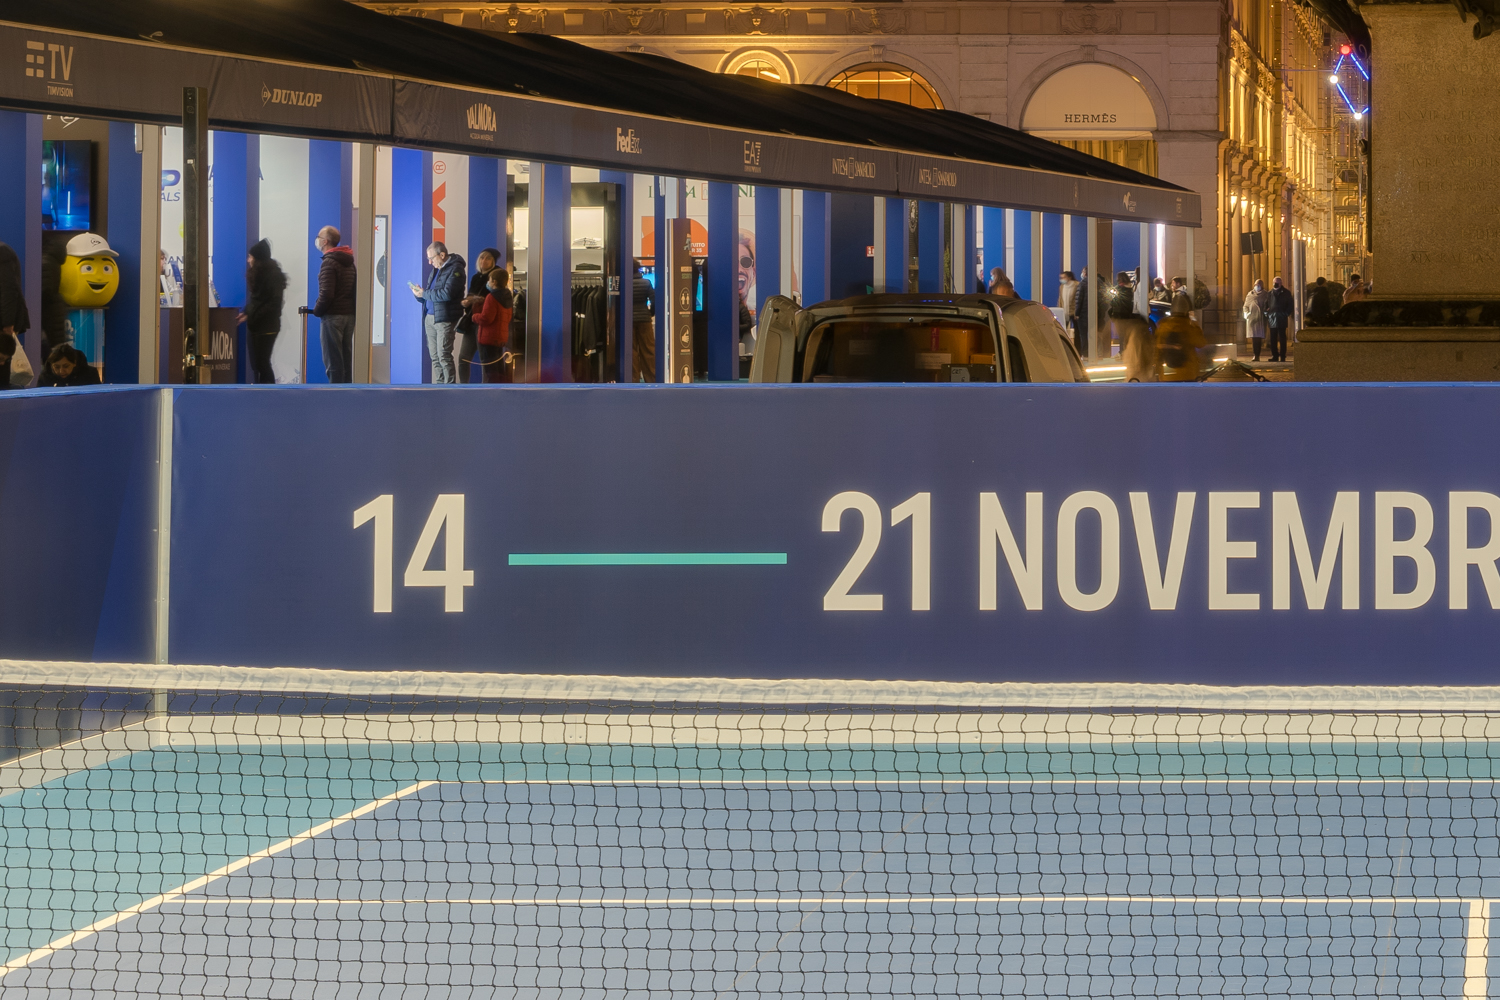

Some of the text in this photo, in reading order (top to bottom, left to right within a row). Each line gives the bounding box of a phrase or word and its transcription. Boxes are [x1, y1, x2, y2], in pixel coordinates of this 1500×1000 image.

[47, 43, 74, 81] TV
[271, 88, 323, 108] DUNLOP
[466, 102, 497, 132] VALMORA
[616, 127, 640, 154] FedEx
[352, 492, 475, 614] 14
[820, 490, 931, 612] 21
